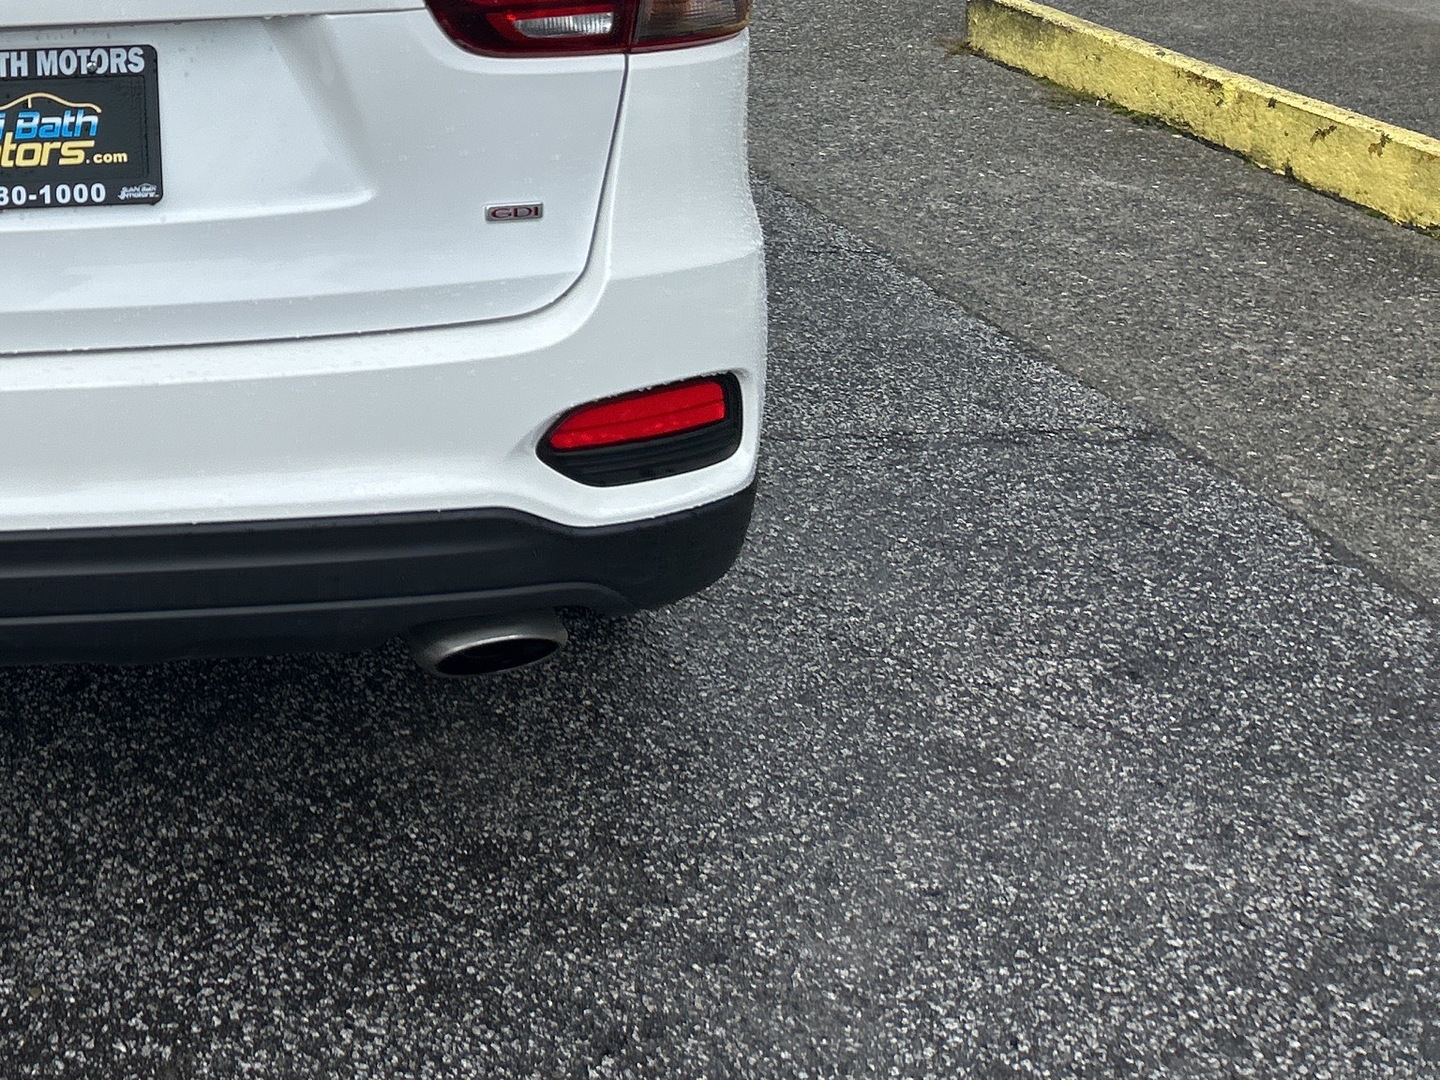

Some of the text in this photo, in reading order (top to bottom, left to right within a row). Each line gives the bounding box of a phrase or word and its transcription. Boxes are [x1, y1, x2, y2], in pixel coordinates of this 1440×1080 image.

[36, 46, 146, 77] MOTORS
[14, 109, 100, 140] Bath
[490, 205, 540, 219] GDI
